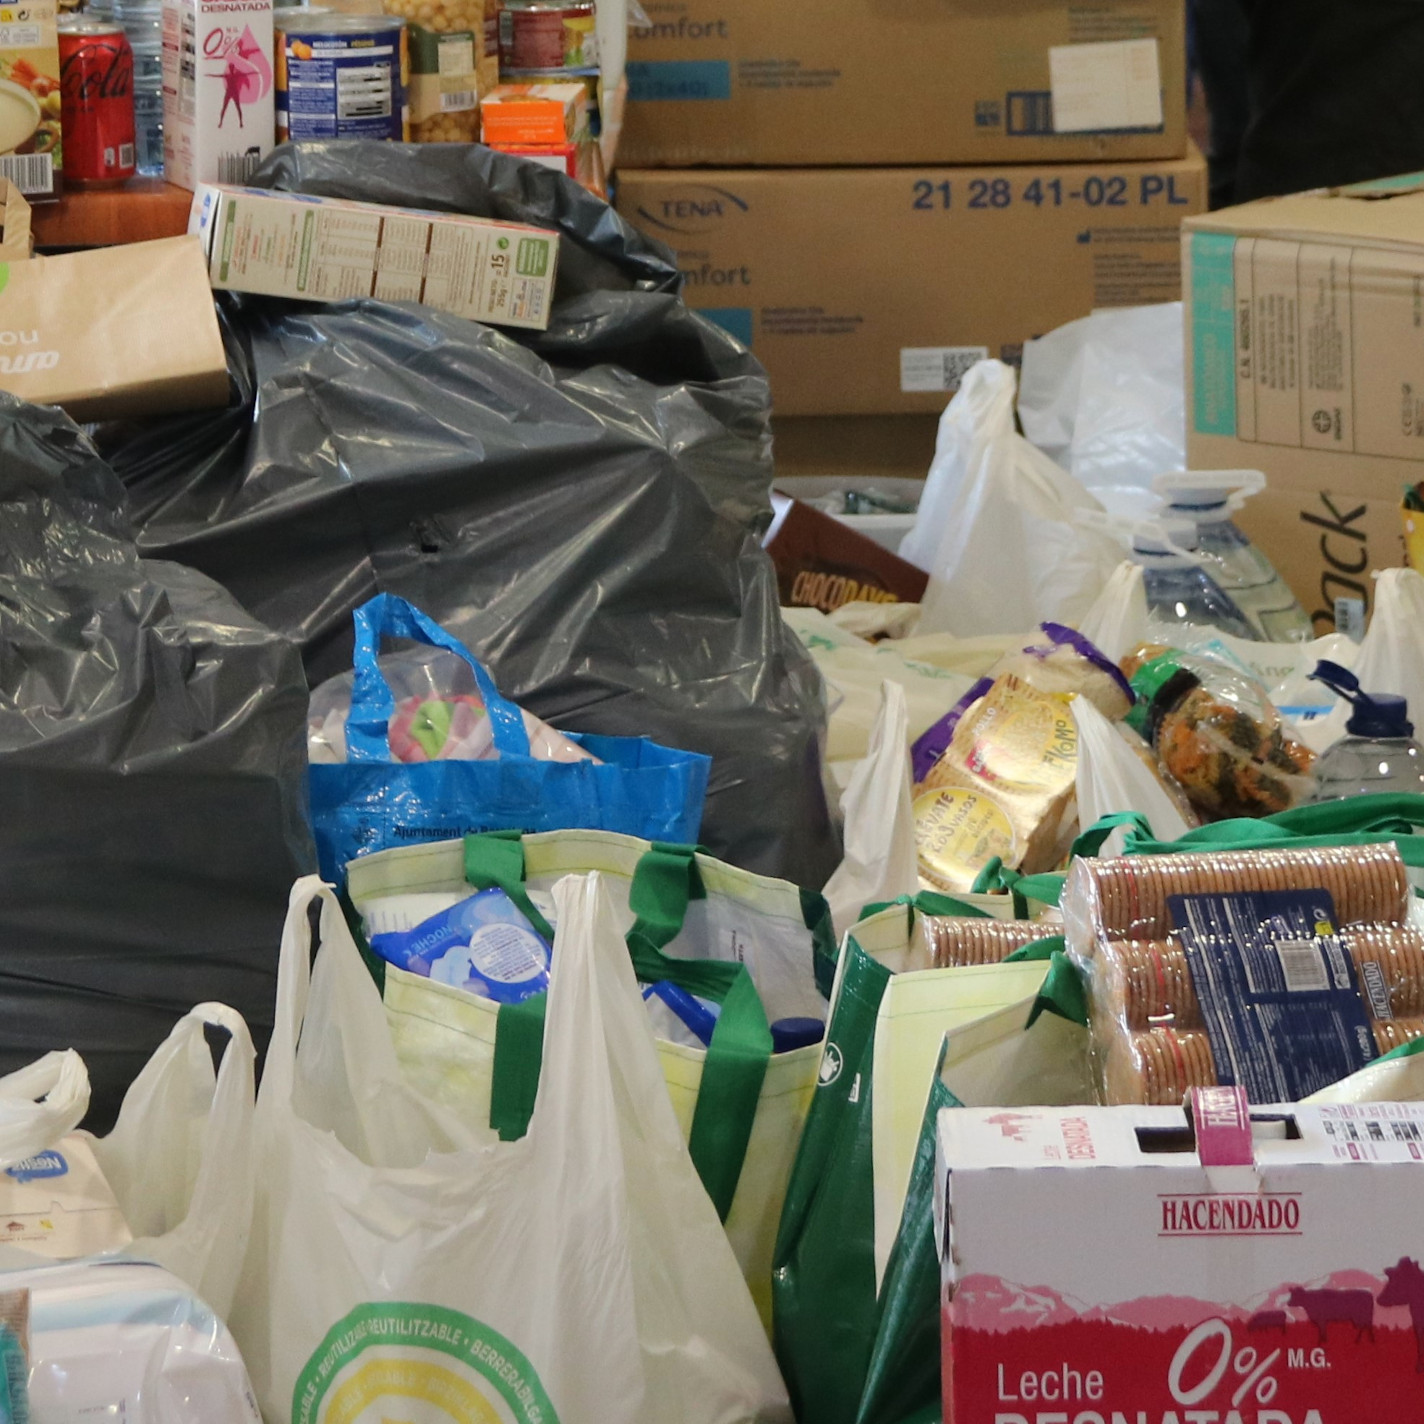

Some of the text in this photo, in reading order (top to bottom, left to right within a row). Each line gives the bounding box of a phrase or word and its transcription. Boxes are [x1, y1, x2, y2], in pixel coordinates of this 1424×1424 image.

[201, 2, 271, 13] DESNATADA
[630, 16, 728, 39] omfort
[662, 199, 723, 218] TENA
[912, 175, 1189, 210] 21 28 41-02 PL
[1362, 961, 1392, 1019] HACENDADO
[1162, 1198, 1300, 1231] HACENDADO
[1167, 1315, 1332, 1408] 0% M.G.
[996, 1362, 1105, 1402] Leche
